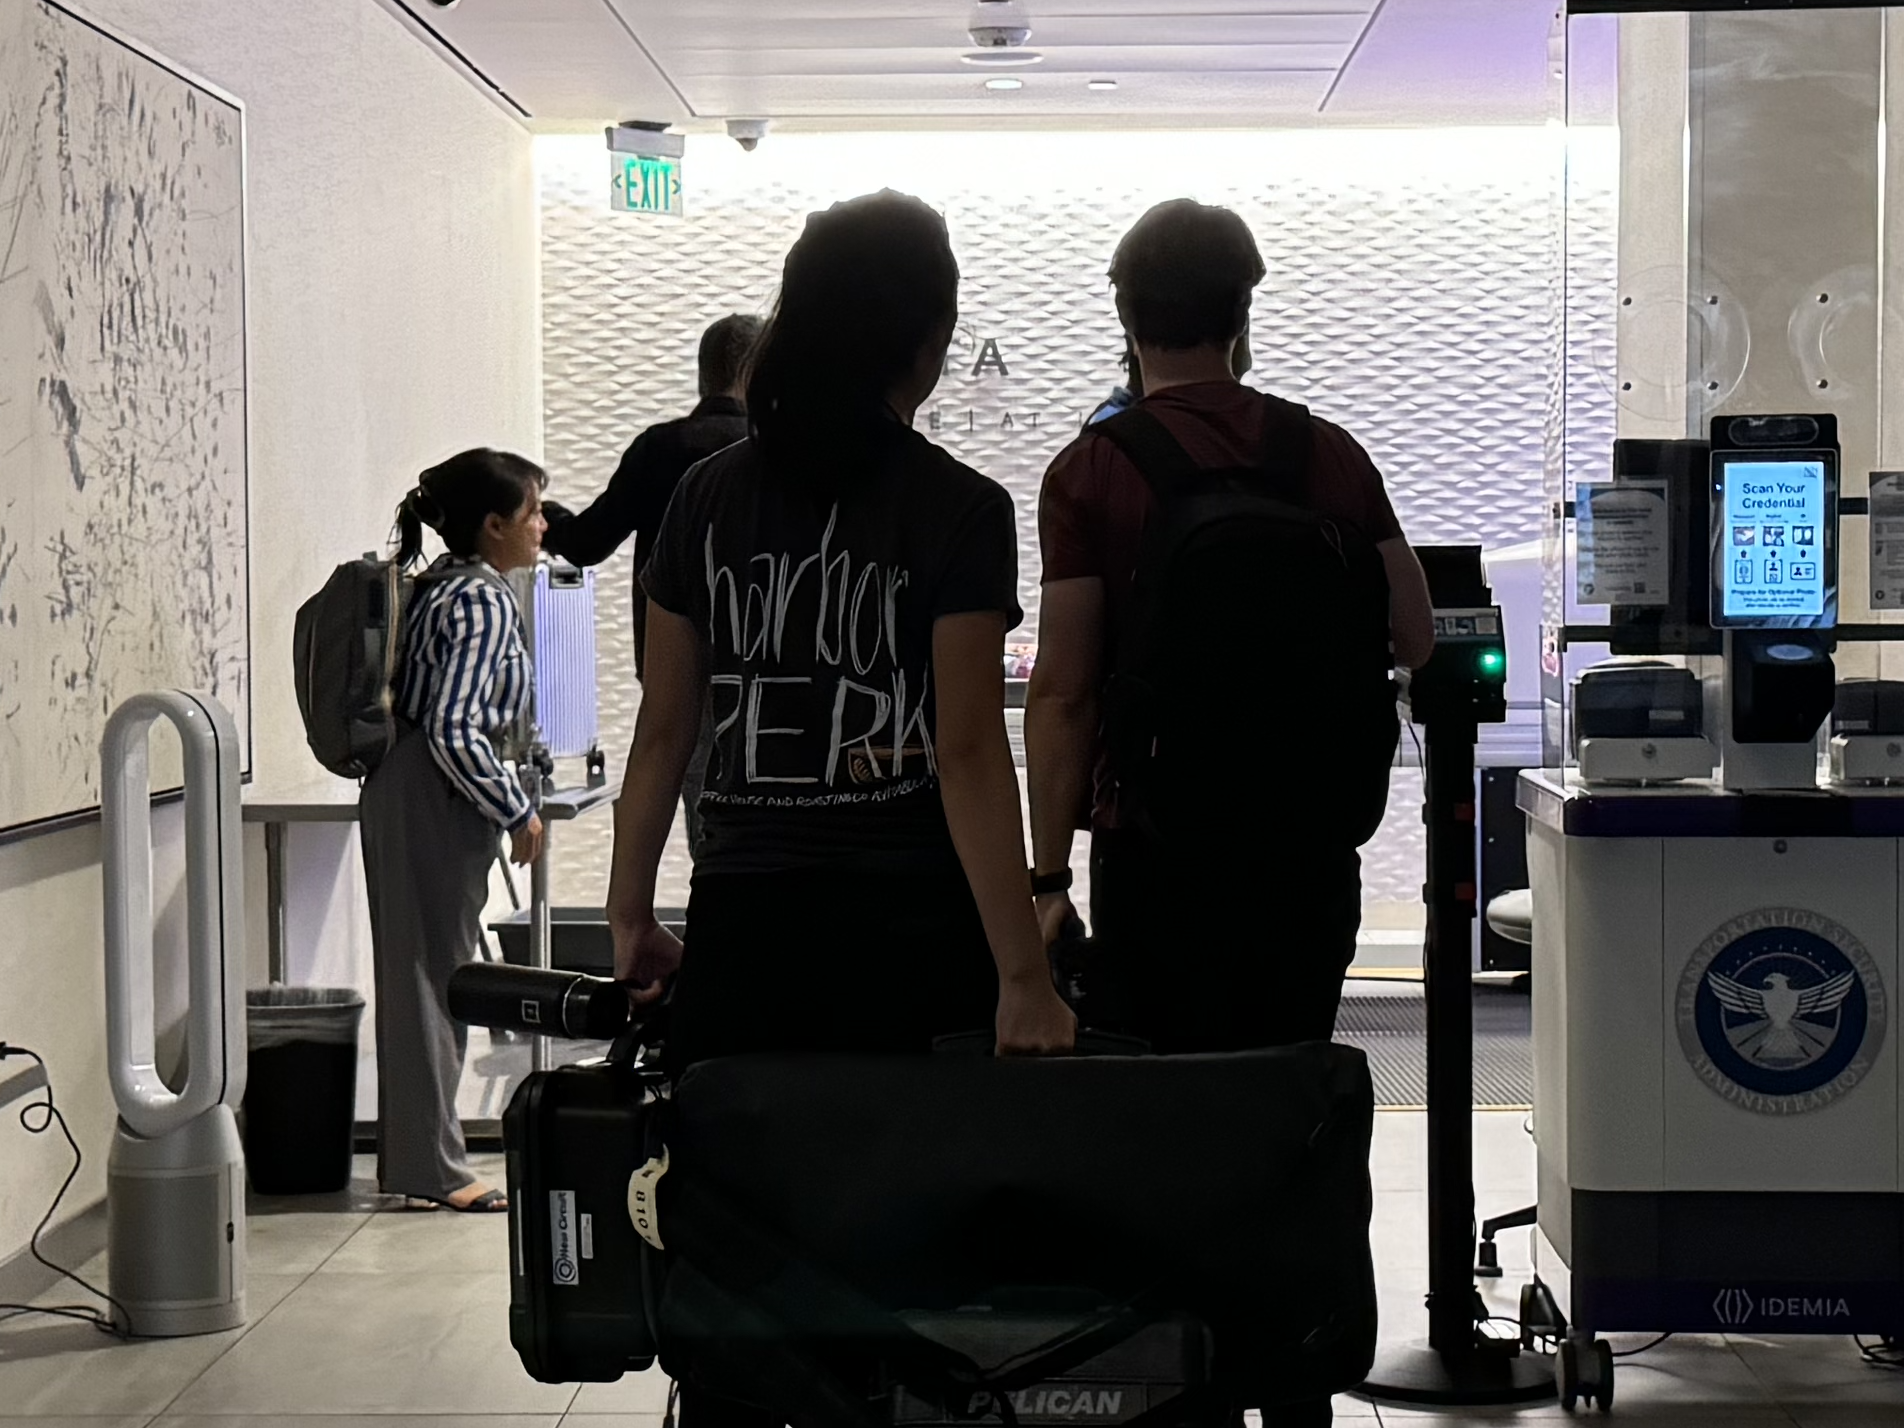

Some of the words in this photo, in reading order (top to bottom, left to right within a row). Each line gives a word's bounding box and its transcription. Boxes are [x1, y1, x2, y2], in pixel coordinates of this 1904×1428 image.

[624, 158, 672, 211] EXIT
[1742, 482, 1774, 494] Scan
[1776, 482, 1806, 494] Your
[1742, 497, 1805, 509] Credential
[766, 796, 794, 807] AND
[1760, 1297, 1851, 1317] IDEMIA
